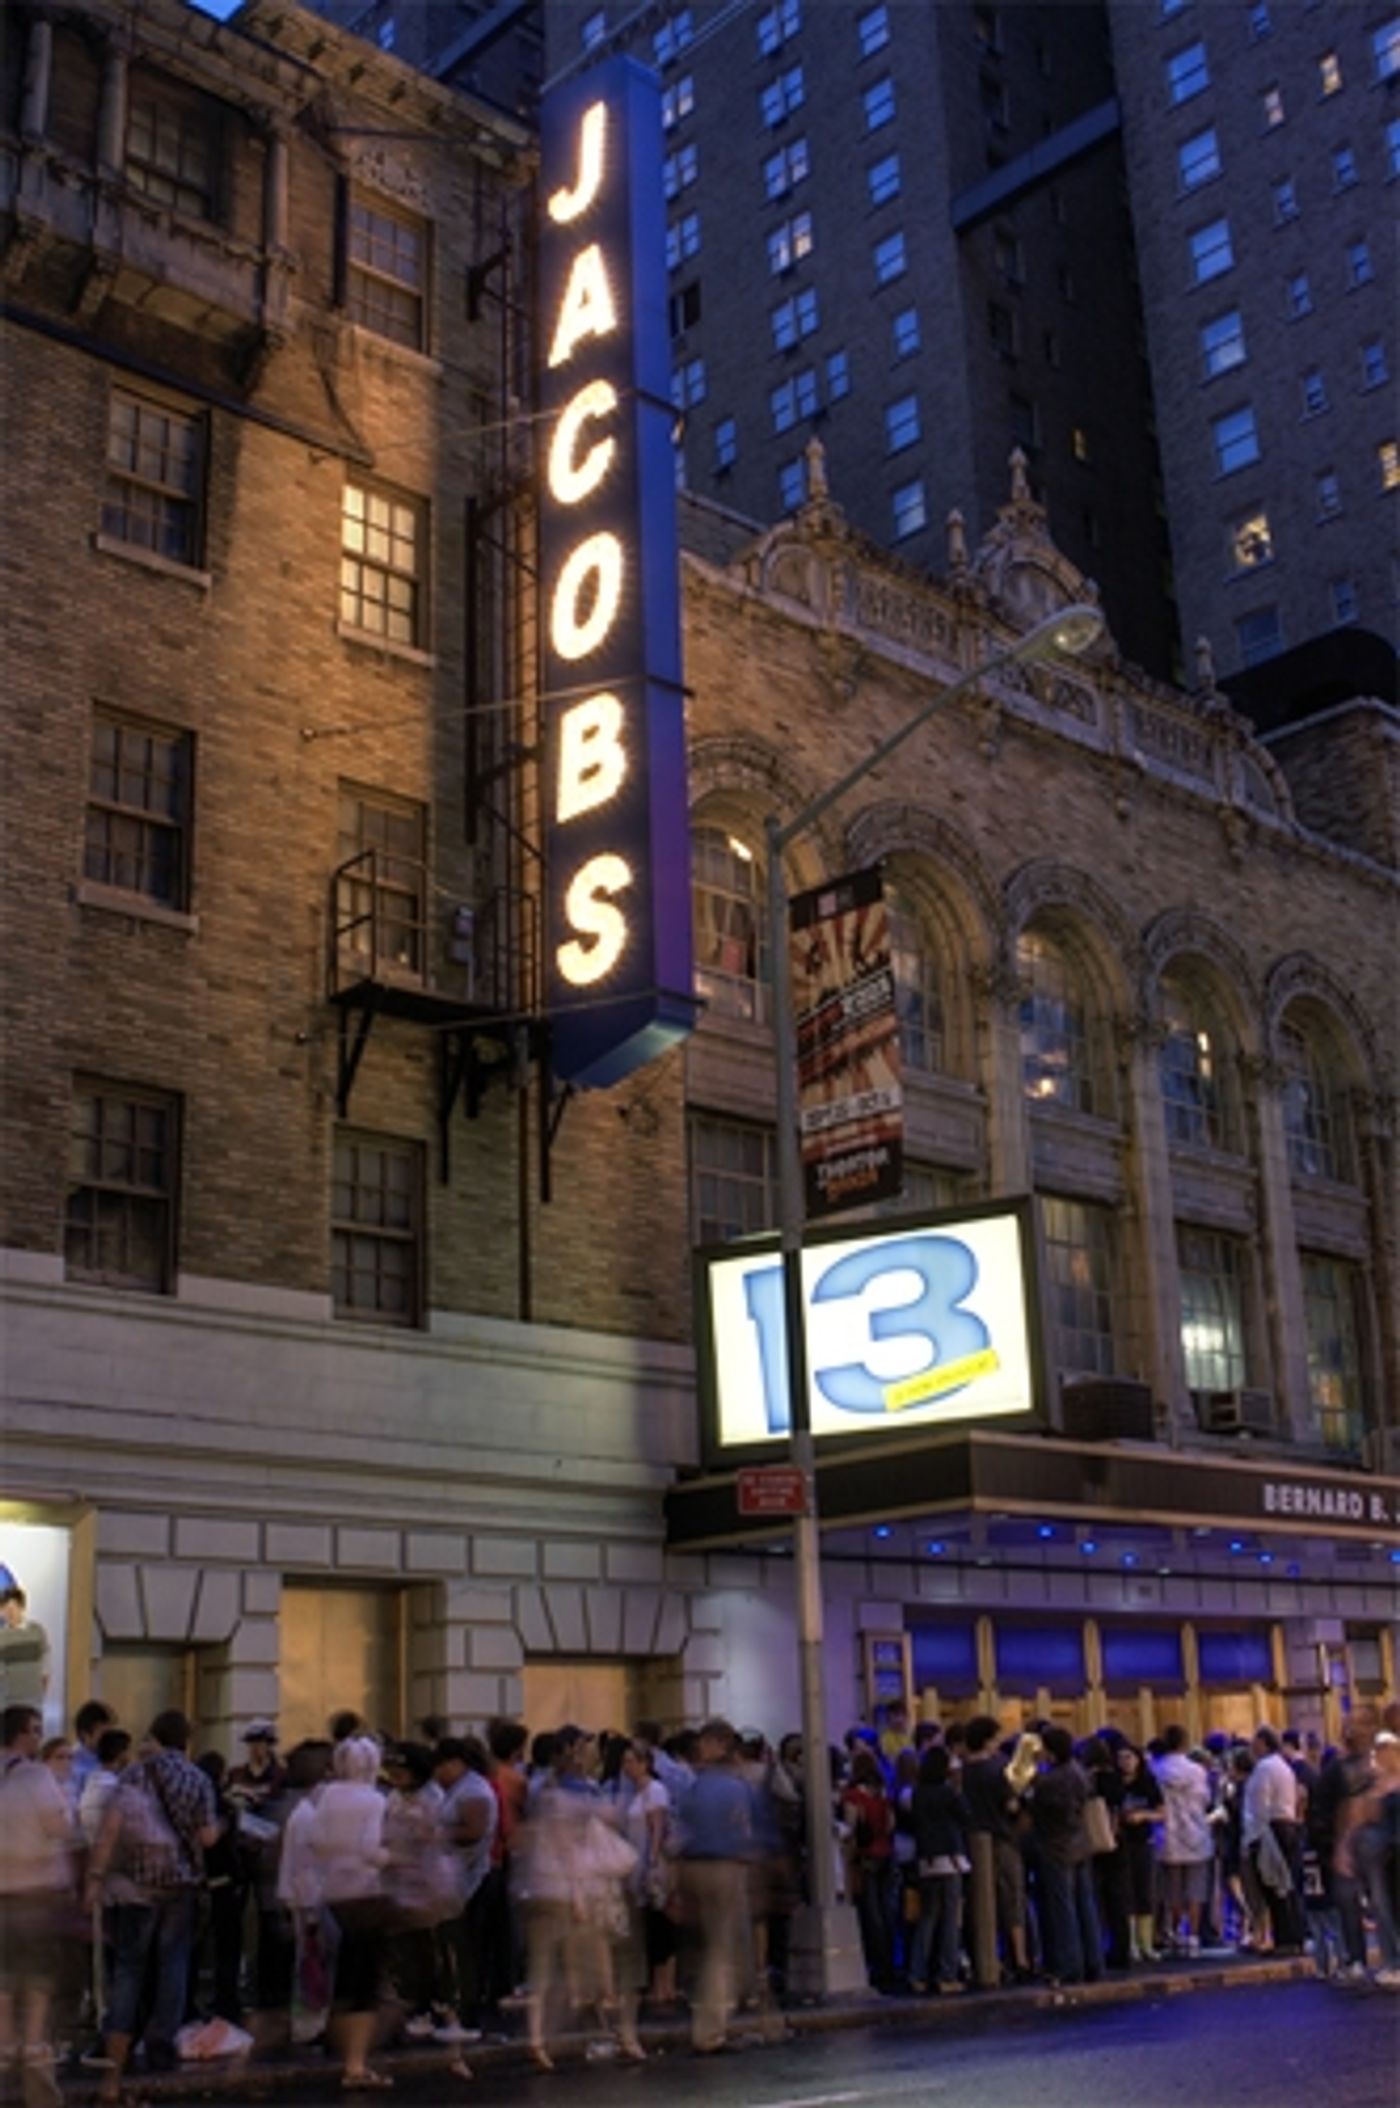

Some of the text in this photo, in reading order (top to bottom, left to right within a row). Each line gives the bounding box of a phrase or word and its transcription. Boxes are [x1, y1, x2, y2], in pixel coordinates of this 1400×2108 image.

[546, 99, 634, 986] JACOBS
[742, 1235, 992, 1435] 13
[1264, 1483, 1364, 1519] BERNARD
